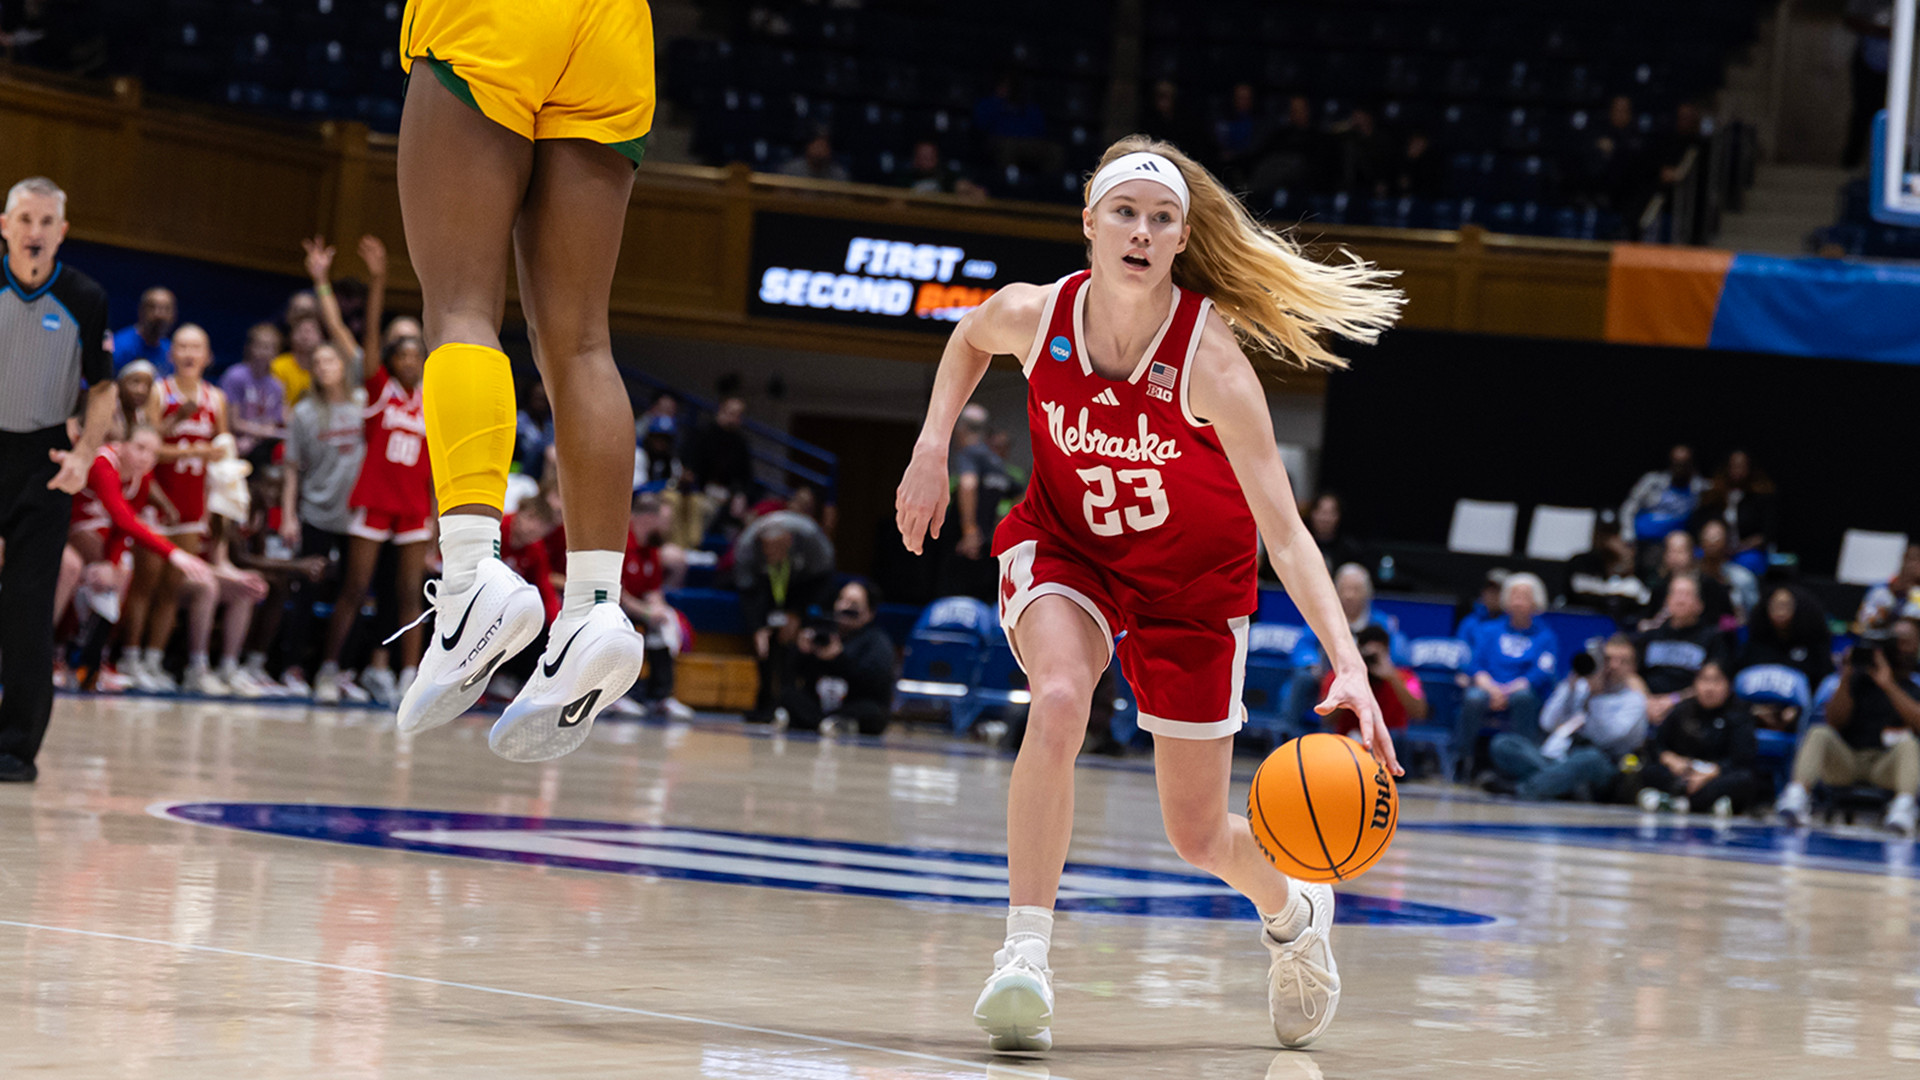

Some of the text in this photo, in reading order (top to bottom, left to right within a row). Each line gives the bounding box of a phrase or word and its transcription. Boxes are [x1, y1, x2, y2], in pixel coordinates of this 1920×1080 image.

[845, 237, 965, 282] FIRST
[759, 266, 914, 316] SECOND
[1051, 345, 1070, 358] NCAA
[1041, 400, 1182, 466] Nebraska
[1076, 464, 1170, 537] 23
